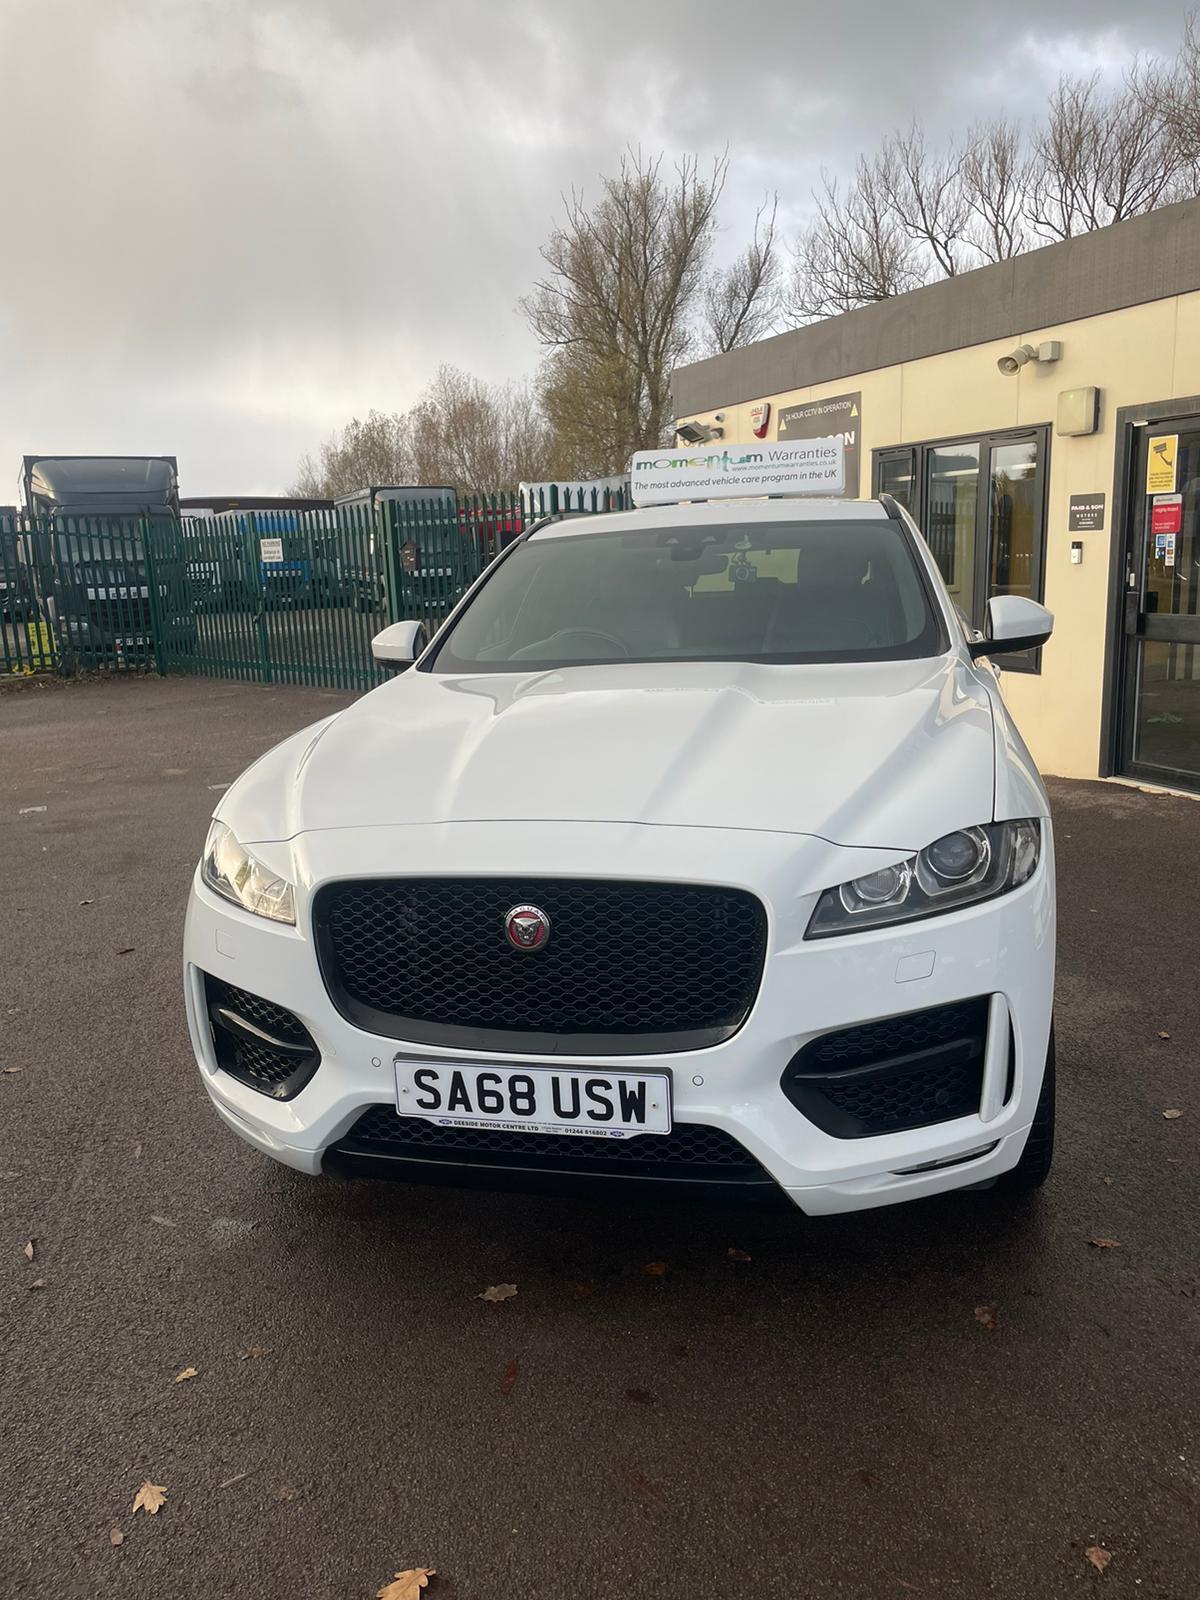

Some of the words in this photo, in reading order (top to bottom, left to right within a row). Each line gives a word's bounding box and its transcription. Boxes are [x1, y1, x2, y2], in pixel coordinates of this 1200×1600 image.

[791, 411, 804, 419] HOUR
[804, 408, 818, 417] CCTV
[818, 407, 823, 415] IN
[823, 401, 852, 413] OPERATION
[635, 450, 763, 473] momentum
[768, 447, 837, 462] Warranties
[731, 459, 837, 472] www.momentumwarranties.co.uk
[634, 481, 648, 490] The
[649, 480, 669, 489] most
[670, 477, 711, 488] advanced
[711, 474, 741, 485] vehicle
[741, 476, 760, 484] care
[761, 473, 798, 484] program
[799, 471, 808, 479] in
[808, 470, 823, 479] the
[823, 469, 838, 478] UK
[413, 1068, 536, 1117] SA68
[551, 1076, 647, 1124] USW
[502, 1123, 526, 1131] CENTRE
